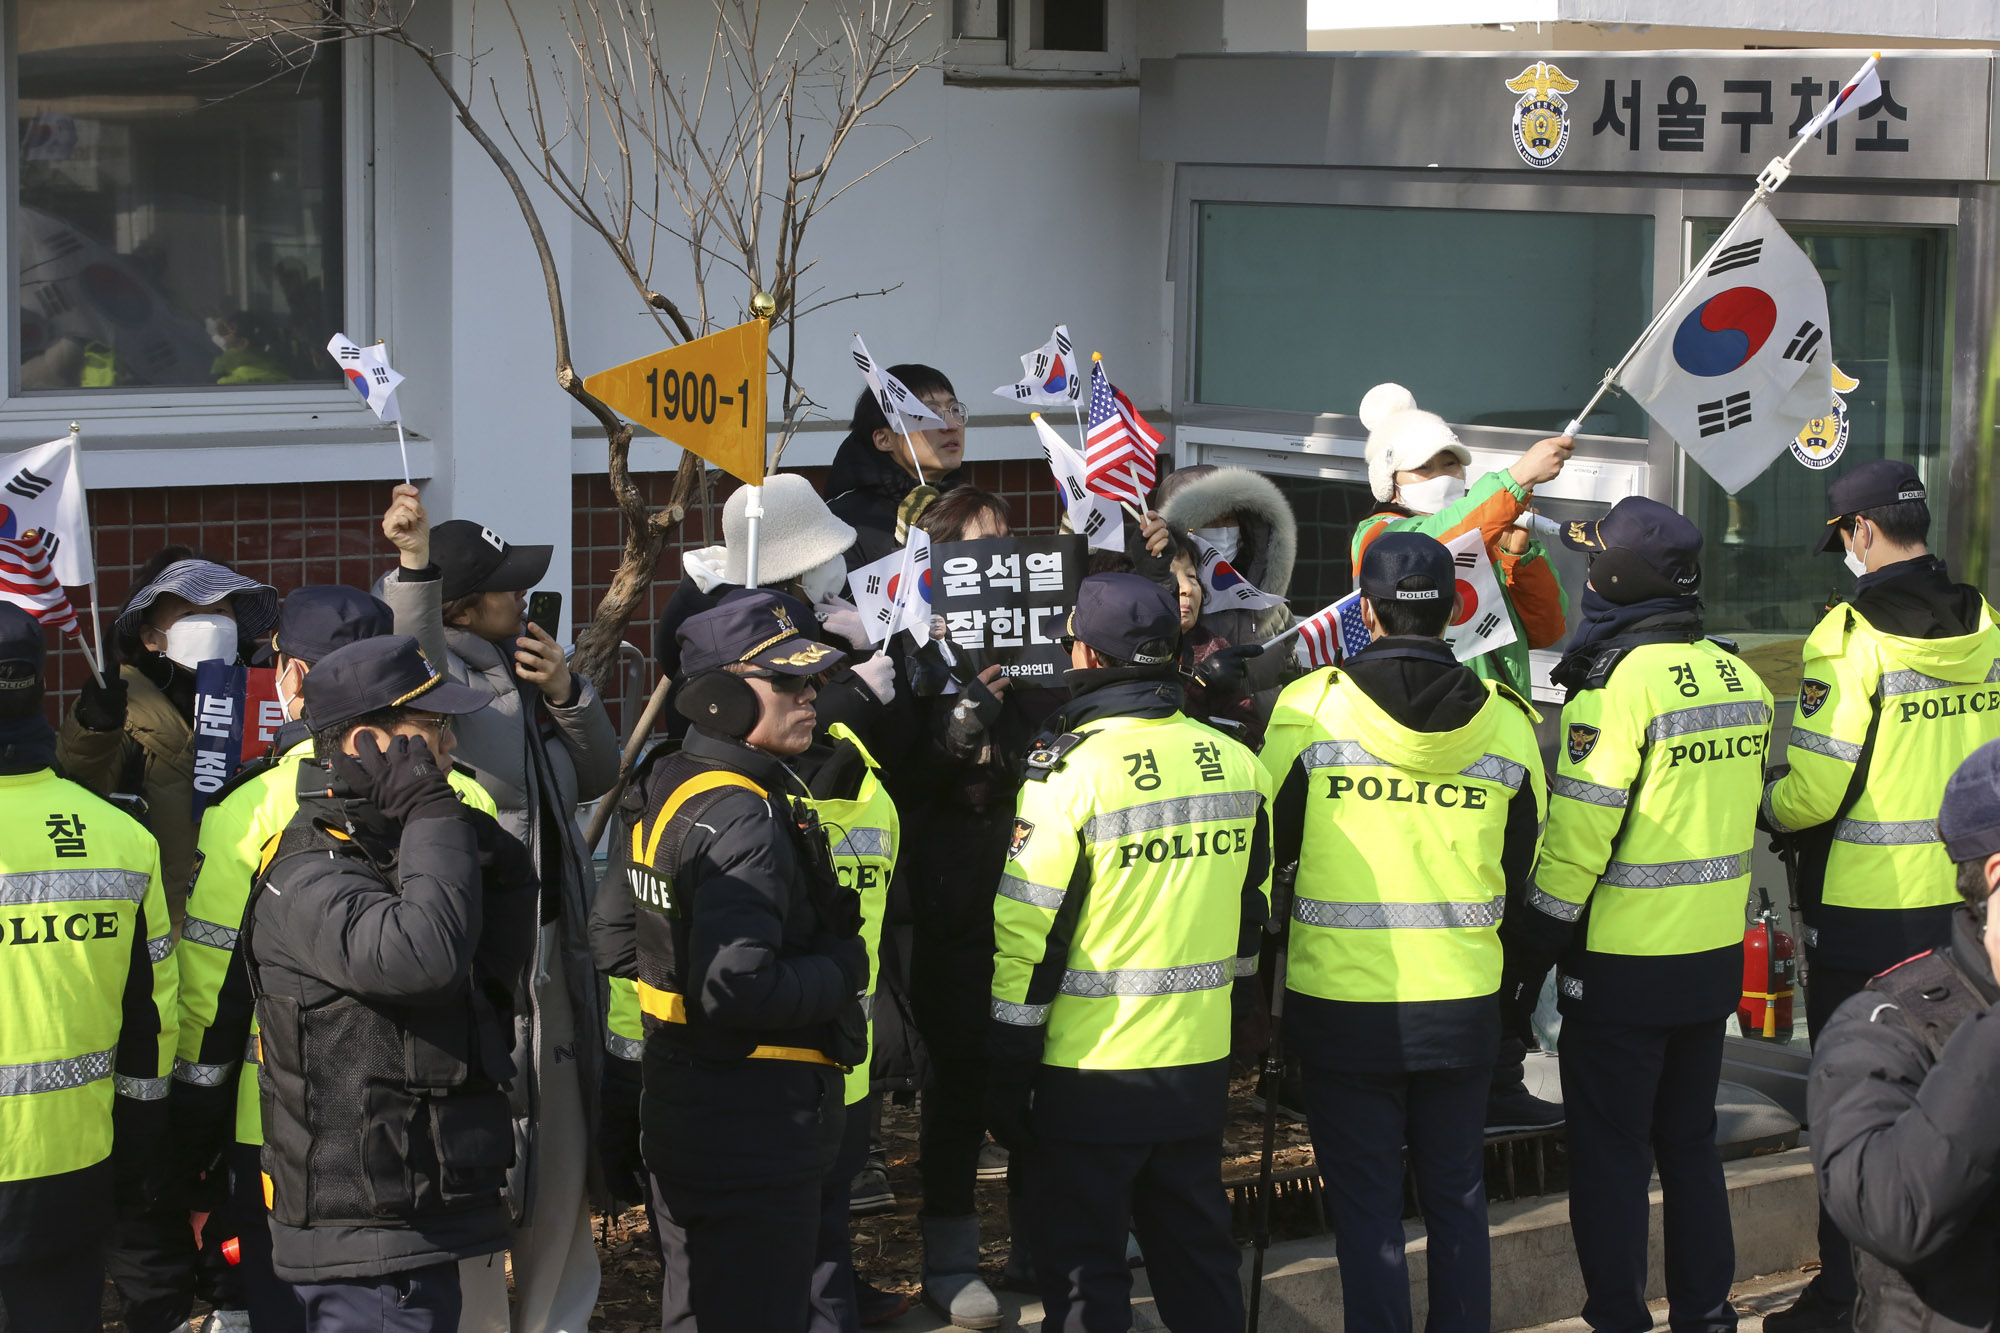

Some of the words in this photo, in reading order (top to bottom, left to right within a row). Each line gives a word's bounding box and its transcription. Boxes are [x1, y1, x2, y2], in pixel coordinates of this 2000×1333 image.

[1593, 75, 1910, 156] 서울구치소
[1522, 148, 1556, 167] CORRECTIONAL
[645, 367, 750, 428] 1900-1
[1795, 448, 1833, 468] CORRECTIONAL
[942, 551, 1065, 597] 윤석열
[1400, 591, 1437, 599] POLICE
[945, 605, 1077, 650] 잘한다
[1000, 663, 1055, 677] 자유와연대
[1901, 690, 2000, 723] POLICE
[1669, 734, 1764, 767] POLICE
[1326, 776, 1488, 811] POLICE
[45, 813, 88, 858] 찰
[1118, 828, 1247, 869] POLICE
[0, 911, 119, 946] LICE
